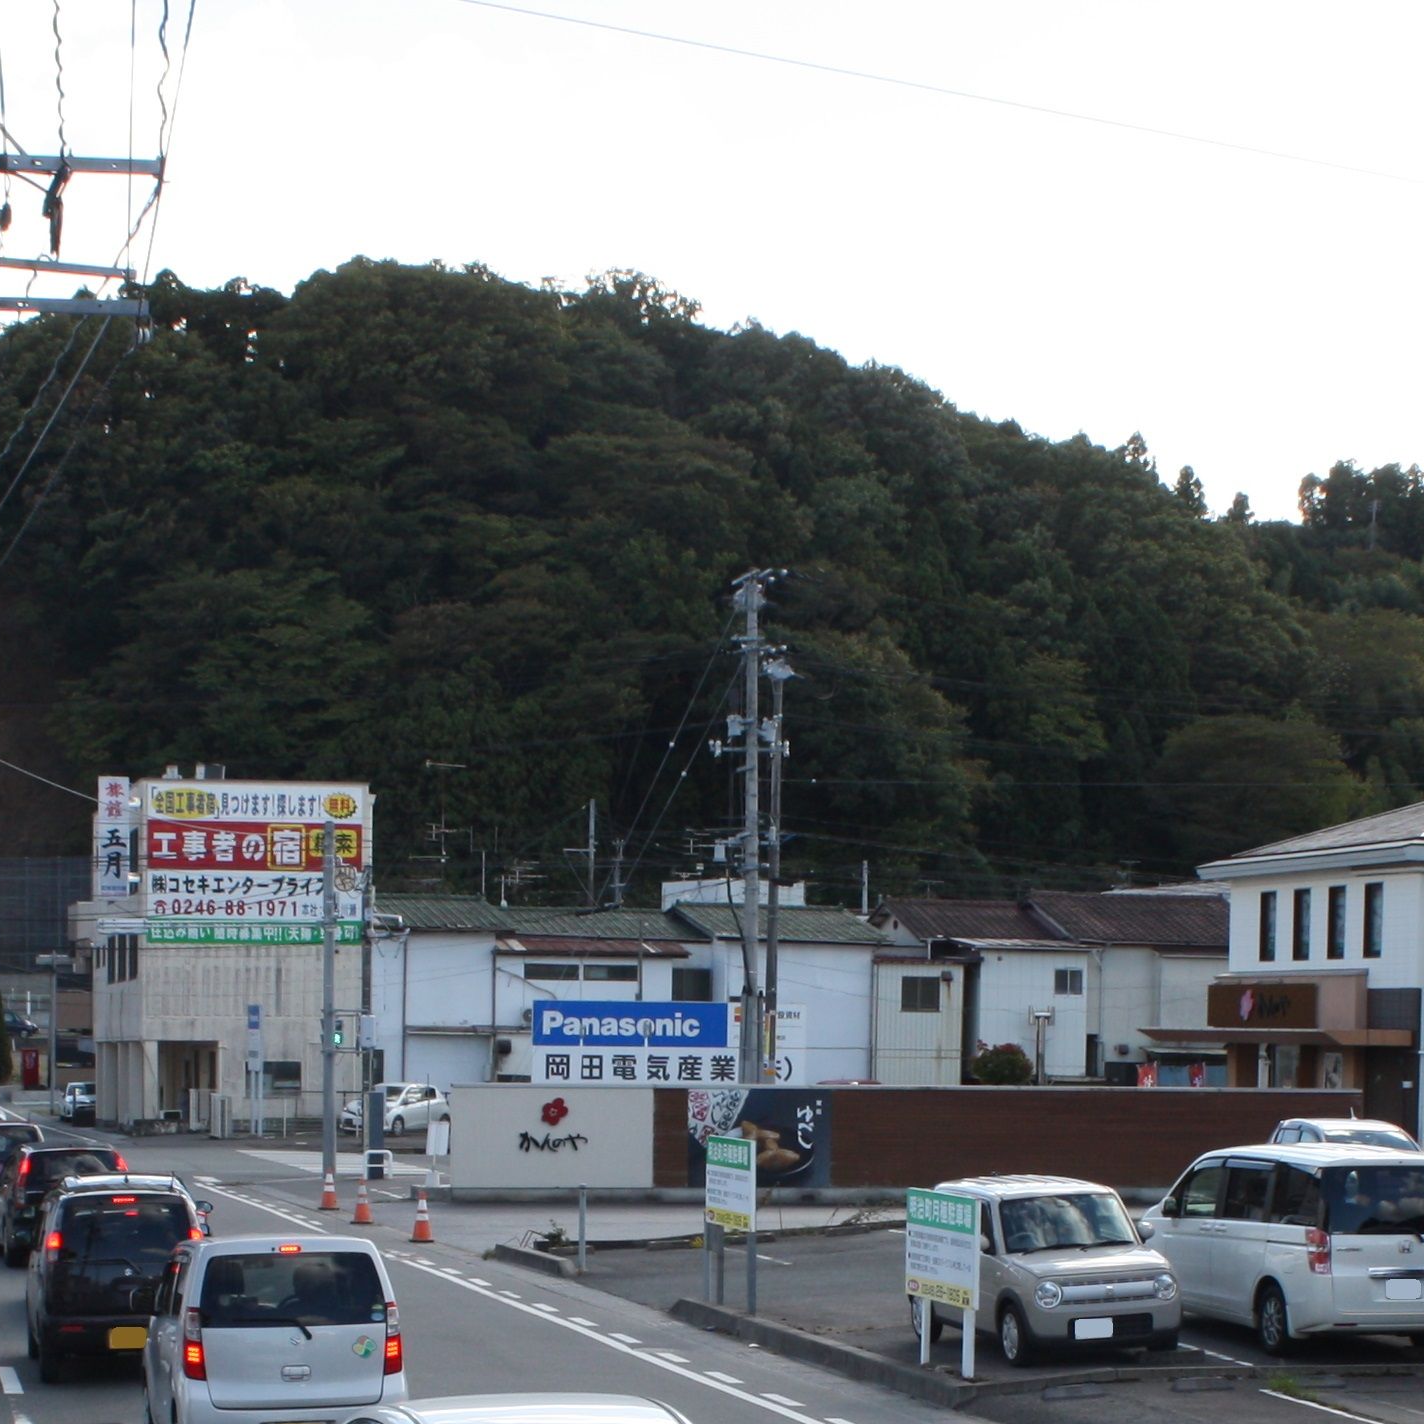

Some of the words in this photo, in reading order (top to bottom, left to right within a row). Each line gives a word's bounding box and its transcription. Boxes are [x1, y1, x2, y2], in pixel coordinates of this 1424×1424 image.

[328, 797, 351, 814] 無料
[102, 828, 126, 879] 五月
[153, 830, 302, 866] 工事者の宿
[172, 899, 298, 917] 0246-88-1971
[542, 1010, 701, 1038] Panasonic
[519, 1131, 588, 1152] かんのや
